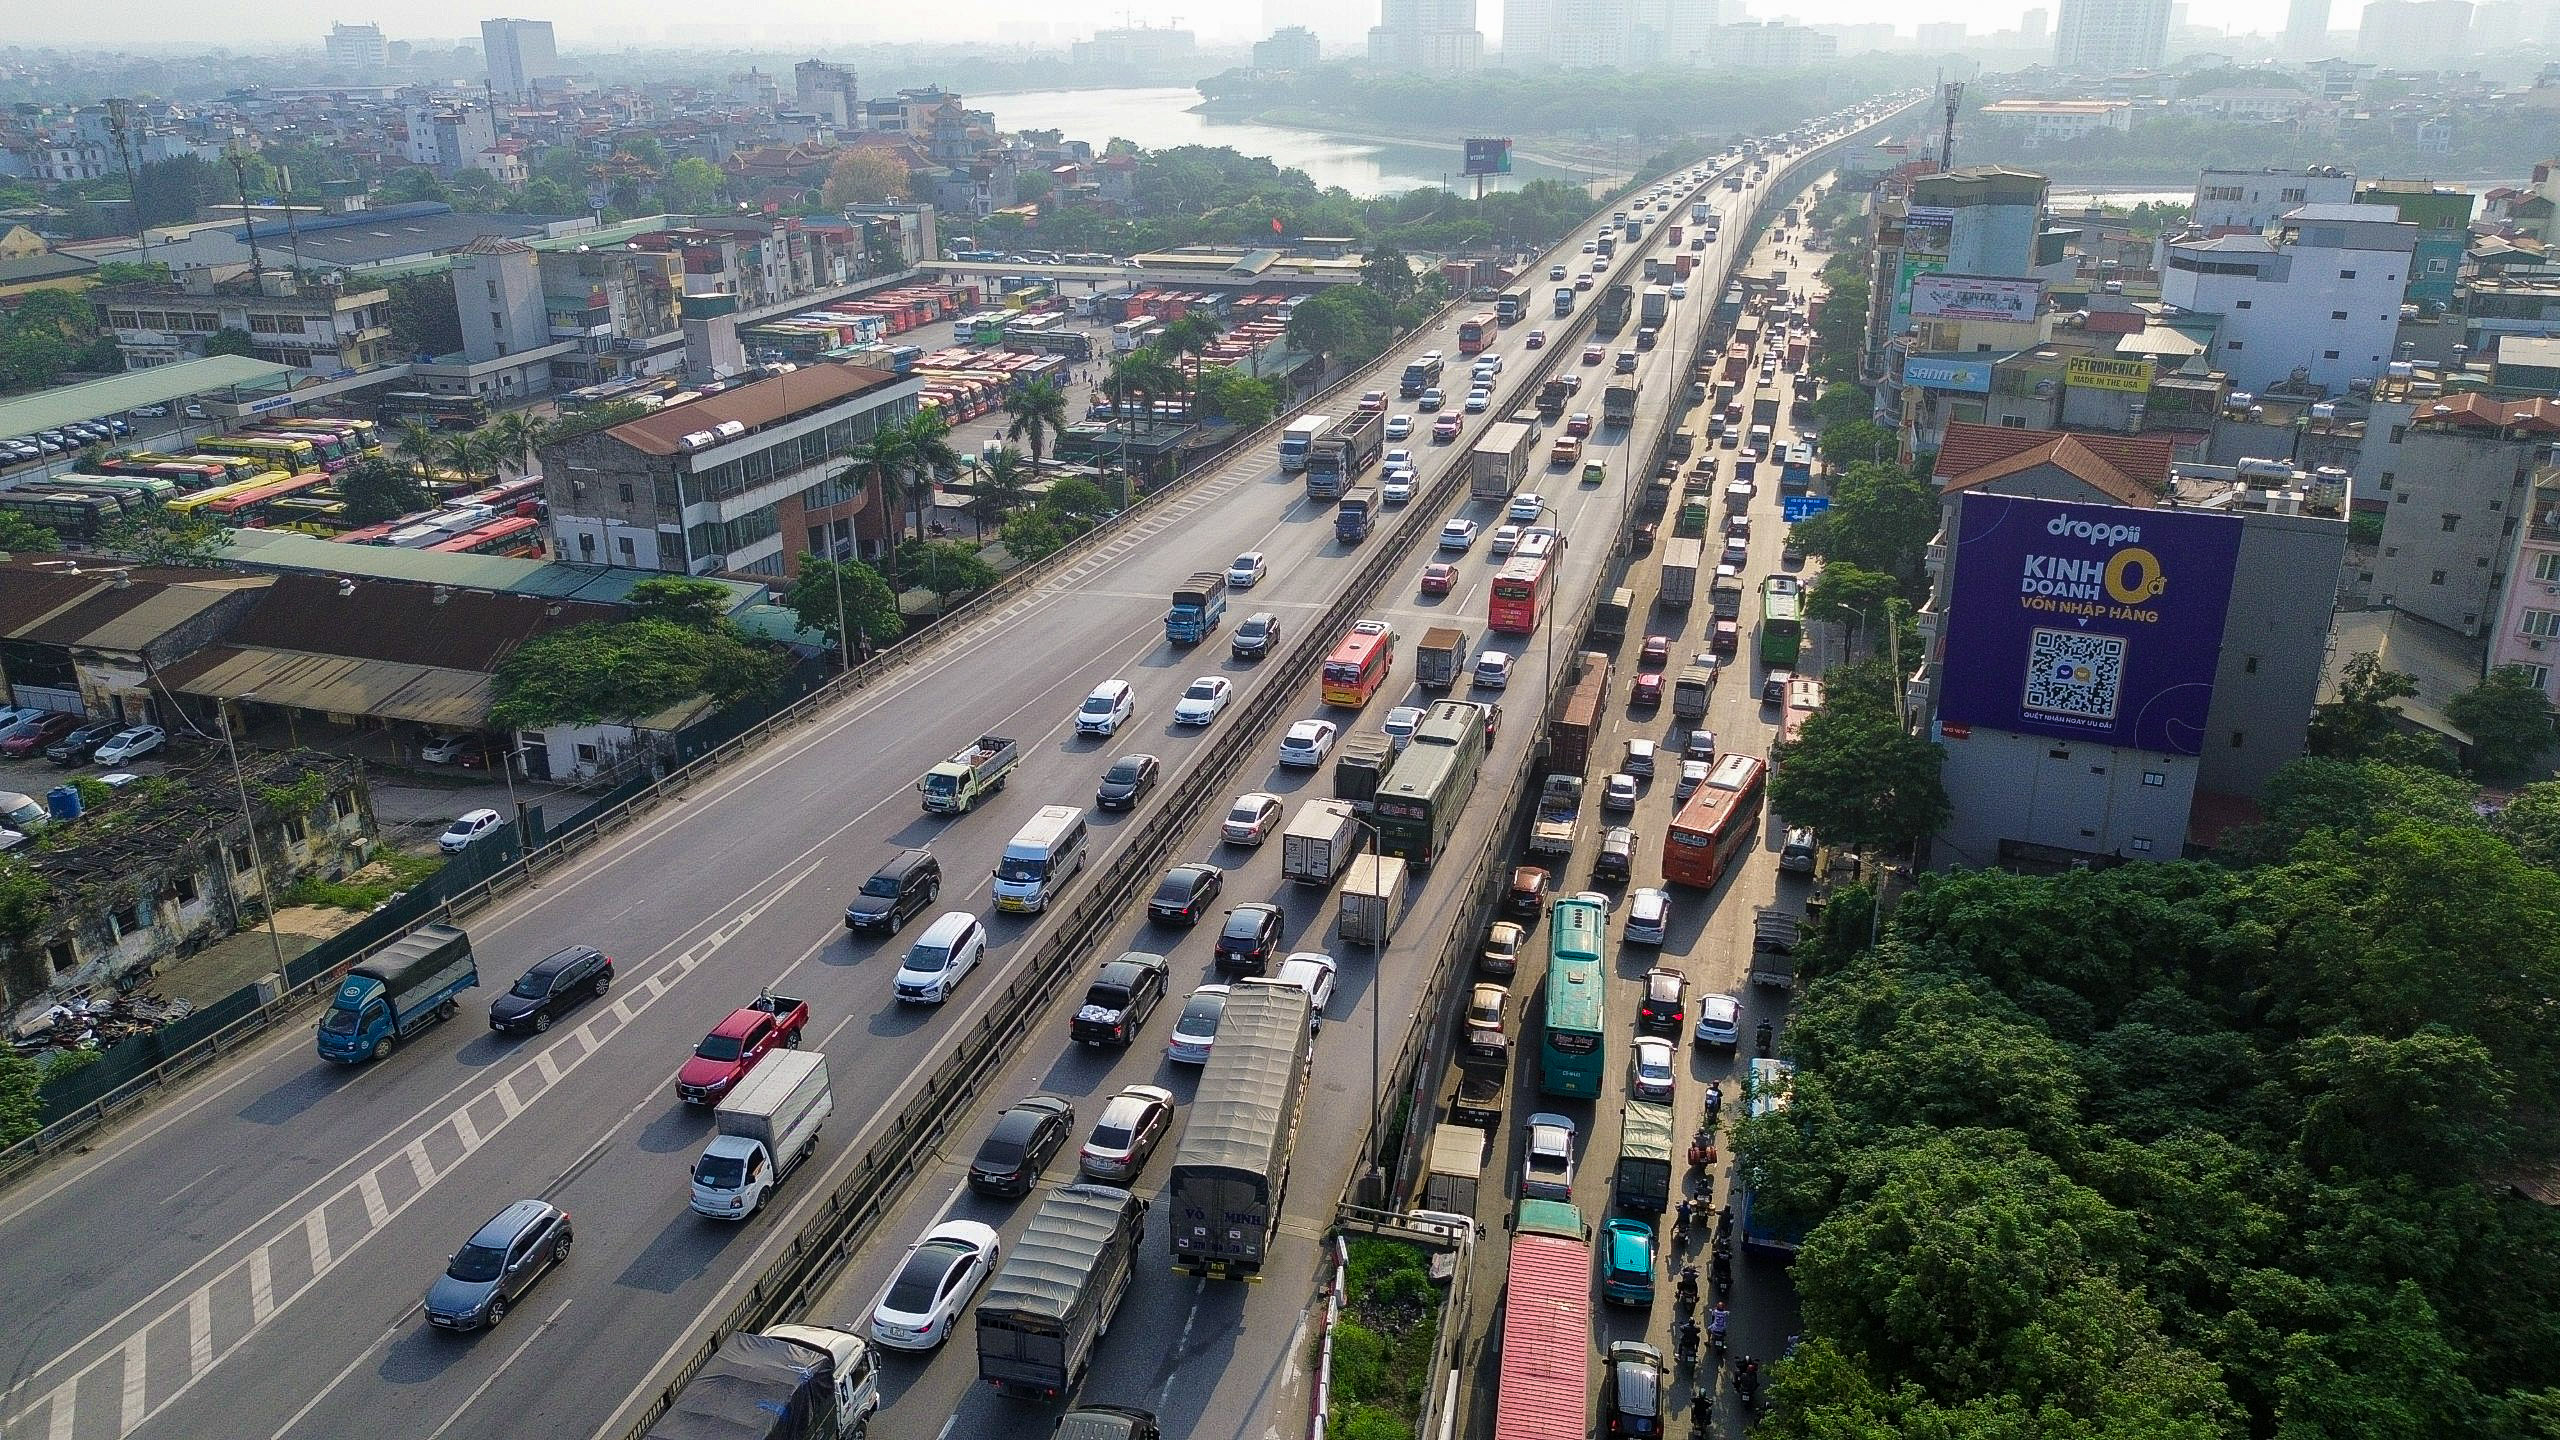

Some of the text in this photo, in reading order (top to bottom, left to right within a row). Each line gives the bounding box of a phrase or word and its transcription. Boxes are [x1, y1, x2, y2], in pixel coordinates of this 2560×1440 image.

[2071, 357, 2142, 377] PETROMERICA
[2073, 375, 2138, 389] MADE IN THE USA
[2047, 513, 2141, 547] droppii
[2023, 554, 2104, 585] KINH
[2021, 577, 2100, 601] DOANH
[2021, 594, 2159, 623] VỐN NHẬP HÀNG
[1224, 1211, 1262, 1225] MINH
